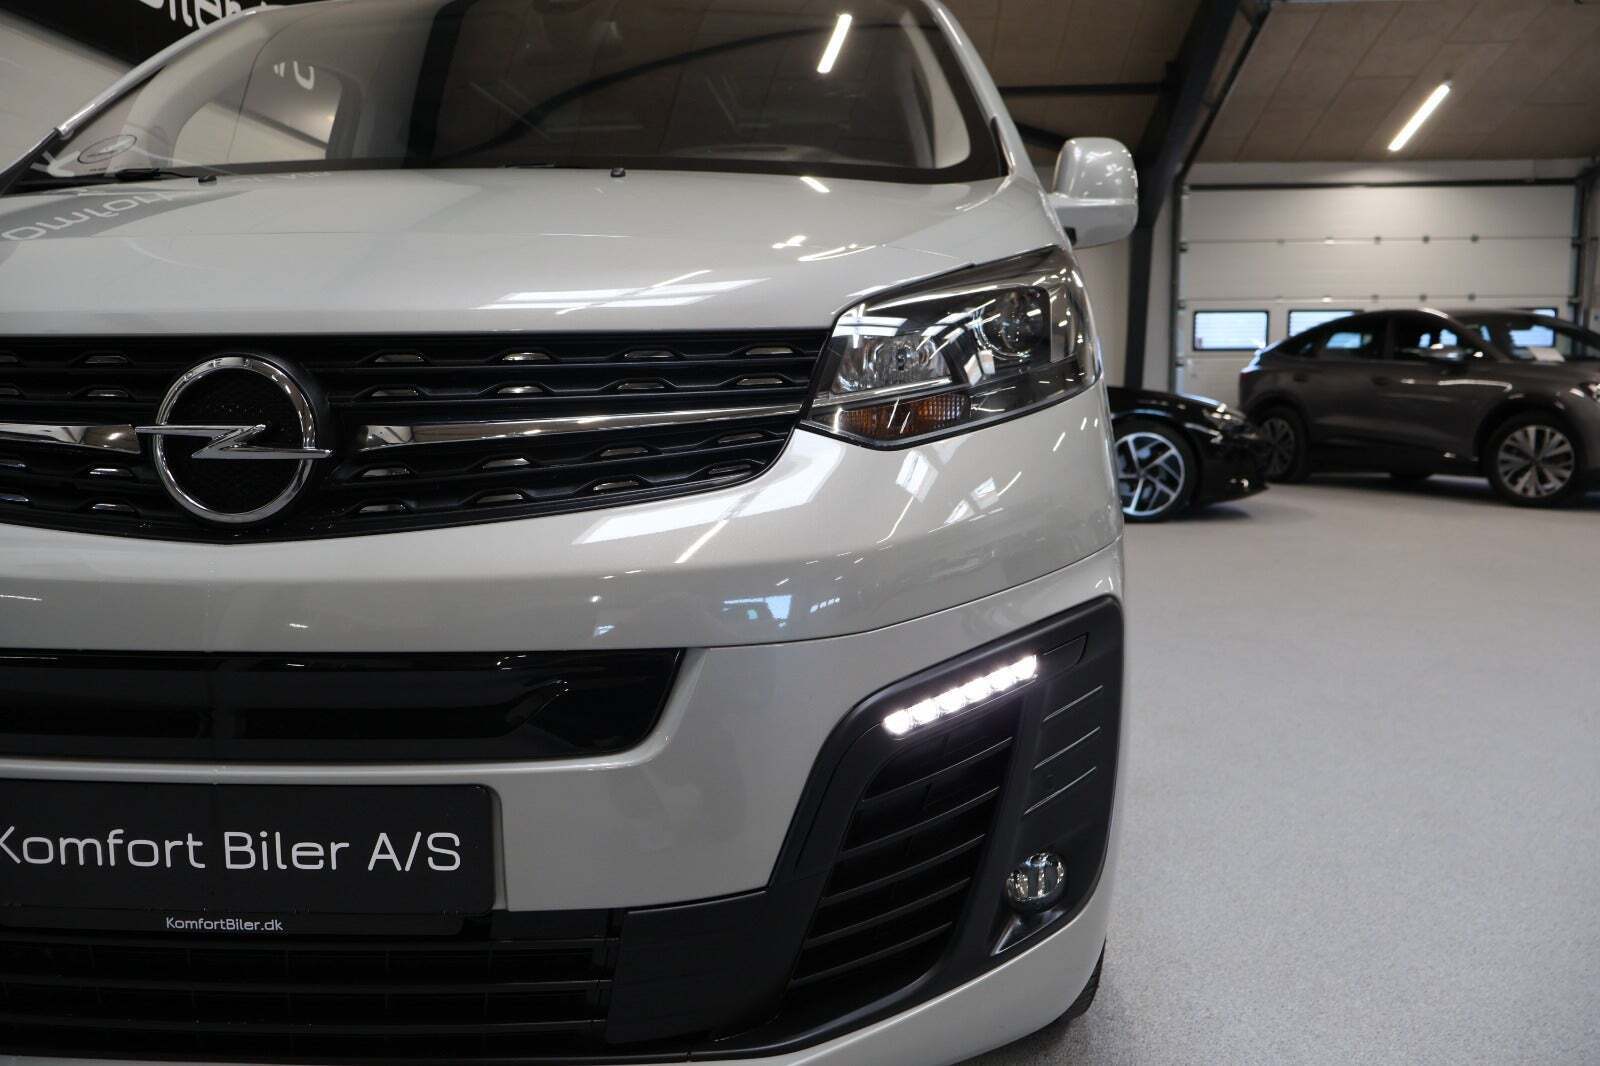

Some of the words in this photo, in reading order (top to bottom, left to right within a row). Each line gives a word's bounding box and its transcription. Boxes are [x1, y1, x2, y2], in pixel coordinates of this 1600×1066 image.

[223, 830, 350, 871] Biler
[367, 830, 462, 872] A/S
[165, 917, 284, 931] KomfortBiler.dk
